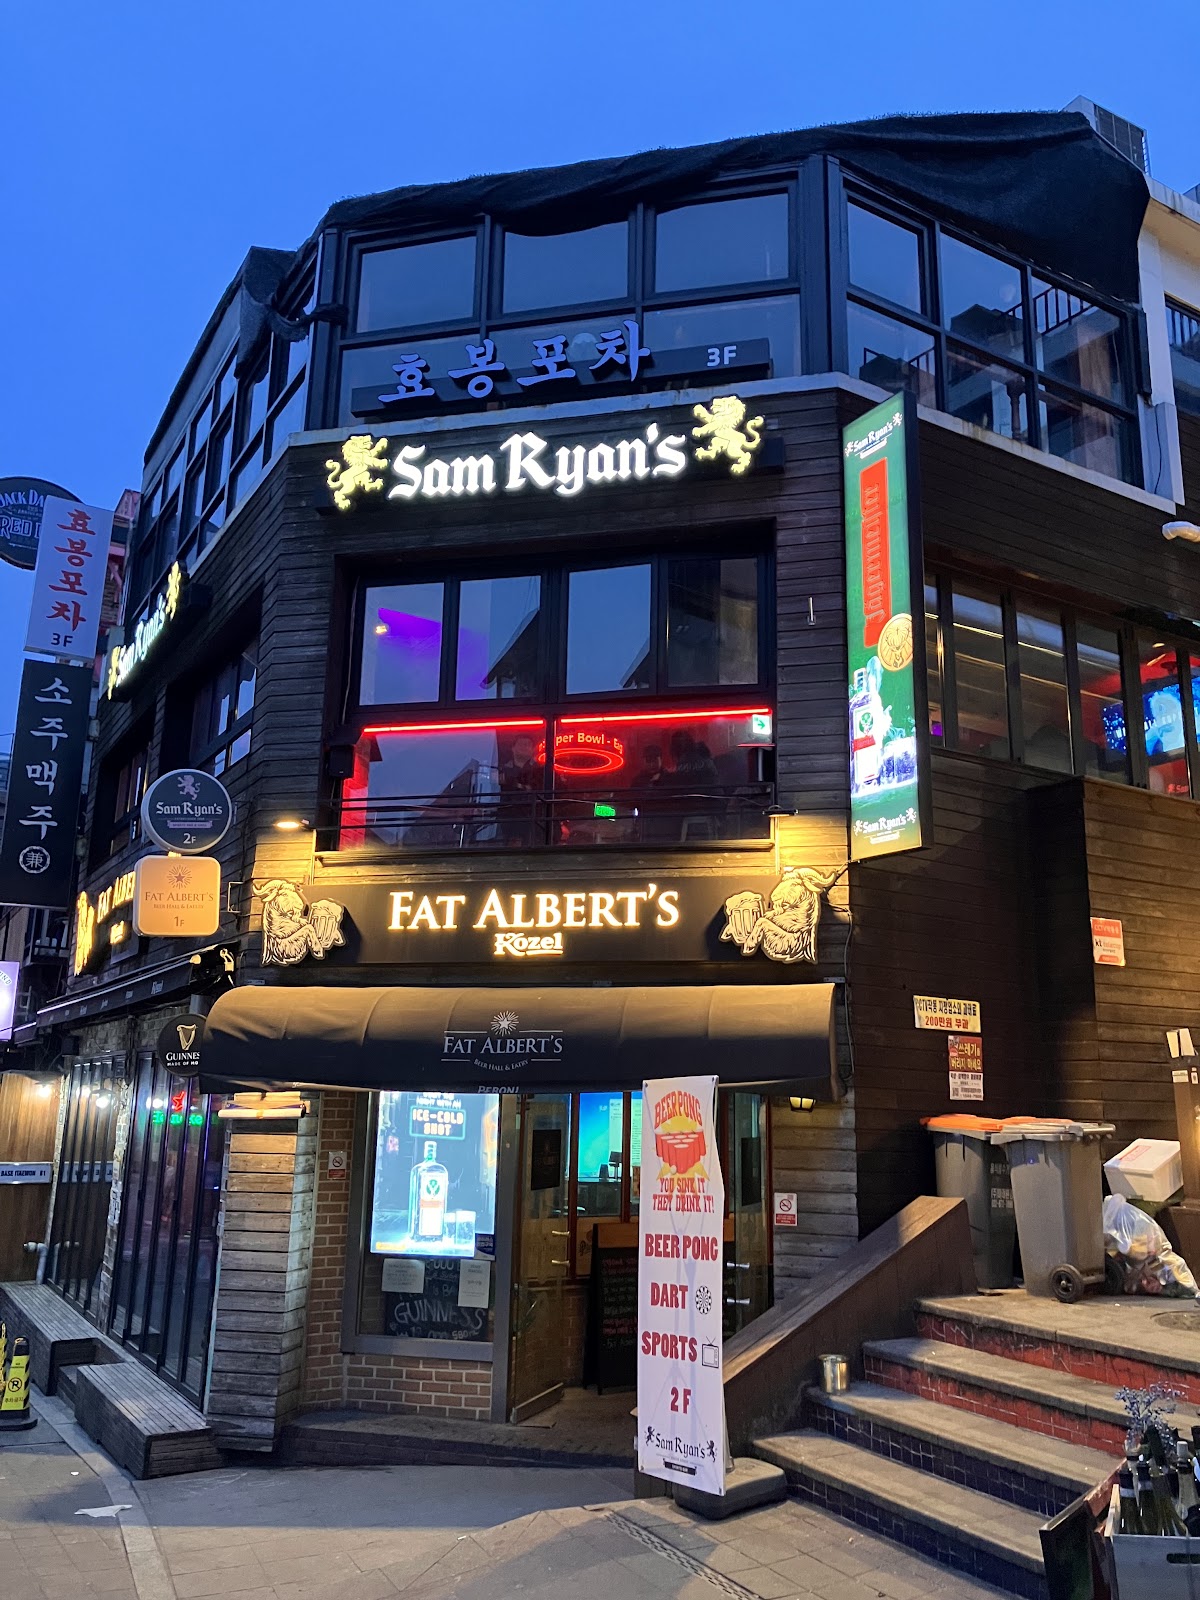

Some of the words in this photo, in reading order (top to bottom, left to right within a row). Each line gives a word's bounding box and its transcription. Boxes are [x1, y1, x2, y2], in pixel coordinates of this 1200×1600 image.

[377, 320, 652, 403] 효봉포차
[706, 345, 737, 368] 3F
[853, 439, 869, 453] Sam
[868, 421, 894, 443] Ryan's
[387, 444, 498, 500] Sam
[499, 421, 686, 495] Ryan's
[46, 508, 97, 632] 효봉포차
[50, 632, 74, 648] 3F
[577, 732, 605, 744] Bowl
[19, 676, 73, 841] 소주맥주
[156, 801, 181, 815] Sam
[181, 801, 223, 817] Ryan's
[861, 820, 879, 834] Sam
[878, 813, 907, 831] Ryan's
[182, 832, 197, 844] 2F
[145, 891, 164, 901] FAT
[167, 891, 215, 902] ALBERT'S
[388, 890, 466, 931] FAT
[472, 882, 680, 930] ALBERT'S
[173, 916, 185, 927] 1F
[493, 932, 564, 957] Kozel
[924, 1015, 953, 1029] 200만원
[442, 1036, 477, 1054] FAT
[480, 1034, 564, 1054] ALBERT'S
[165, 1051, 200, 1061] GUINNES
[473, 1058, 488, 1070] BEER
[488, 1063, 504, 1072] HALL
[412, 1108, 464, 1125] ICE-COLD
[654, 1091, 678, 1130] BEER
[677, 1090, 703, 1127] PONG
[423, 1122, 452, 1136] SHOT
[660, 1177, 674, 1193] YOU
[676, 1177, 696, 1194] SINK
[697, 1177, 706, 1193] IT
[652, 1194, 673, 1212] THEY
[675, 1194, 701, 1214] DRINK
[703, 1195, 715, 1213] IT!
[645, 1233, 680, 1259] BEER
[682, 1235, 719, 1261] PONG
[650, 1282, 689, 1310] DART
[394, 1299, 486, 1330] GUINNESS
[641, 1330, 698, 1363] SPORTS
[655, 1432, 674, 1451] Sam
[674, 1436, 706, 1459] Ryan's
